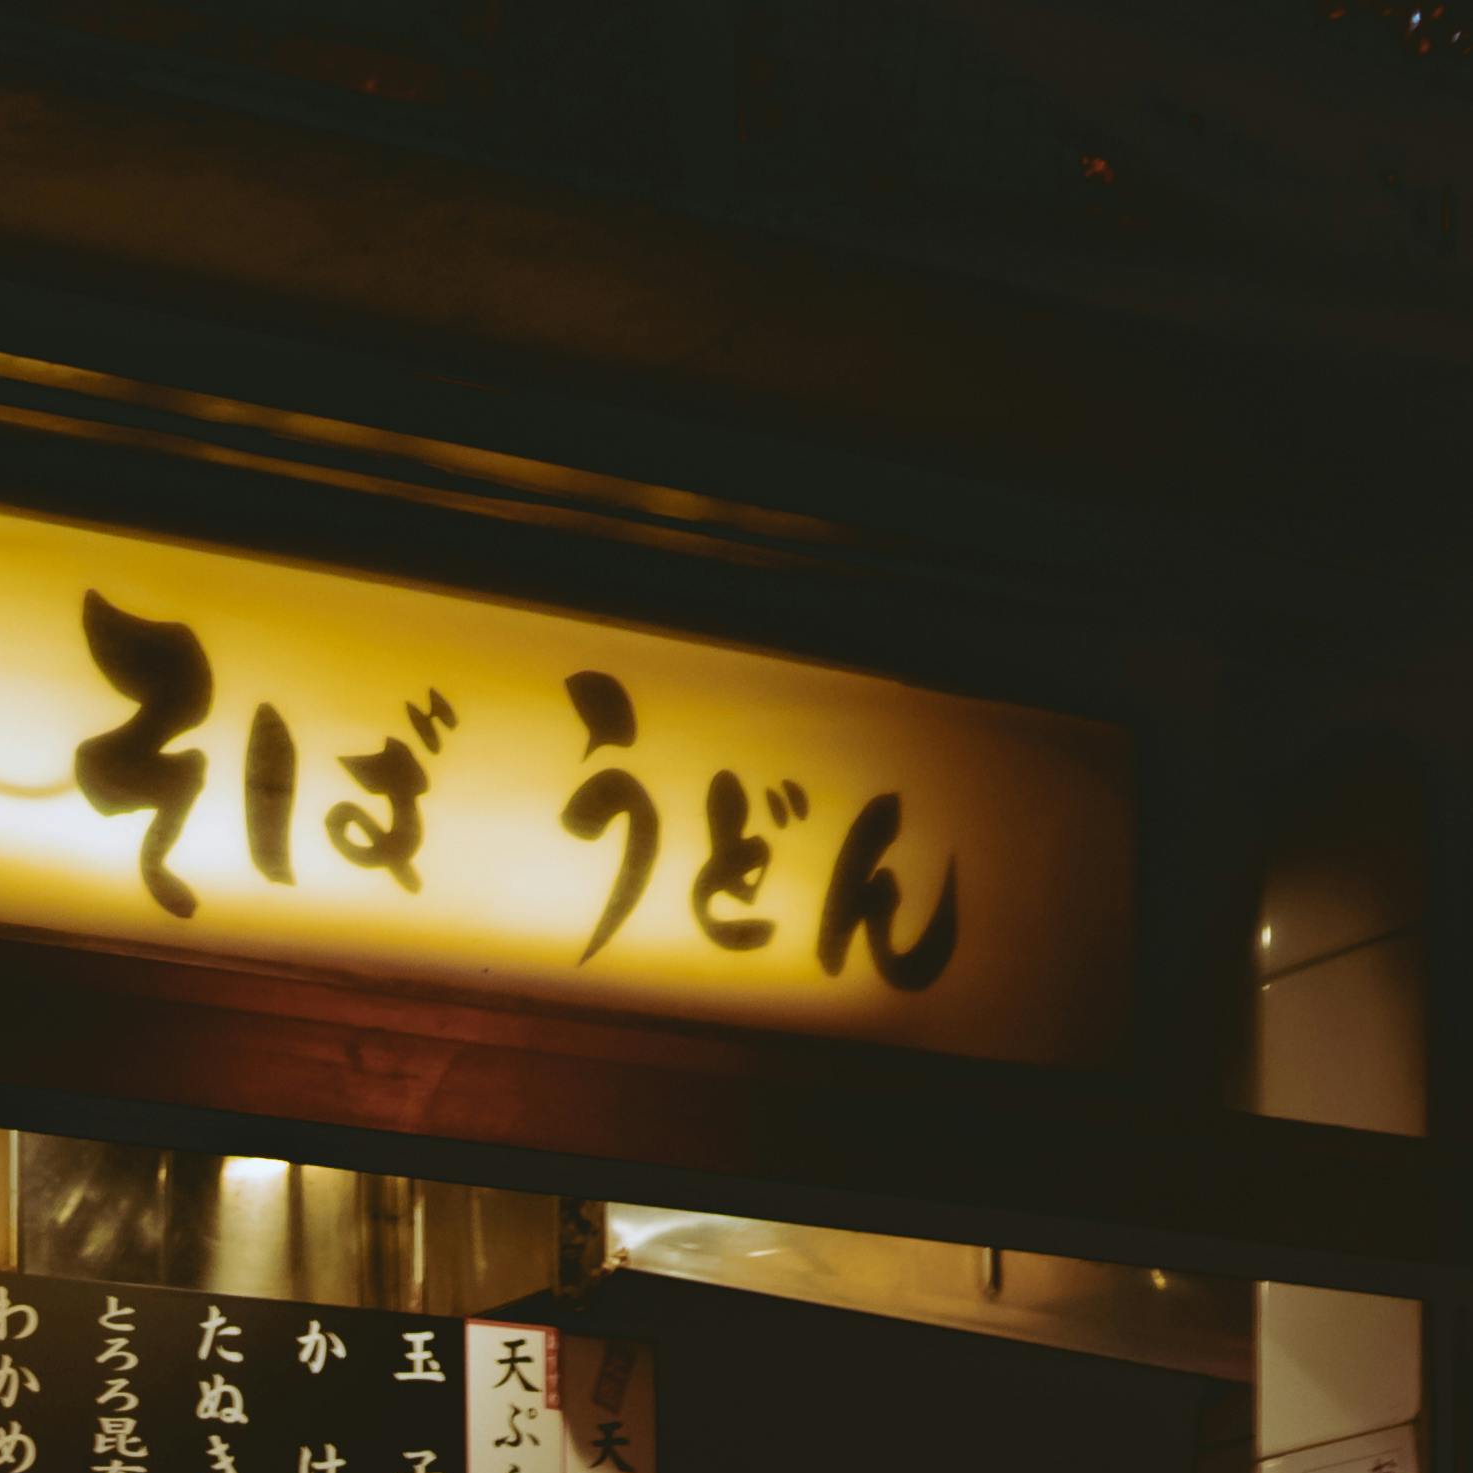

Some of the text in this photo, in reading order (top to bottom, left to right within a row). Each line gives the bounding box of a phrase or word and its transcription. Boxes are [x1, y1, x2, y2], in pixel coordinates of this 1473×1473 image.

[74, 588, 458, 920] そば
[560, 669, 960, 993] うどん
